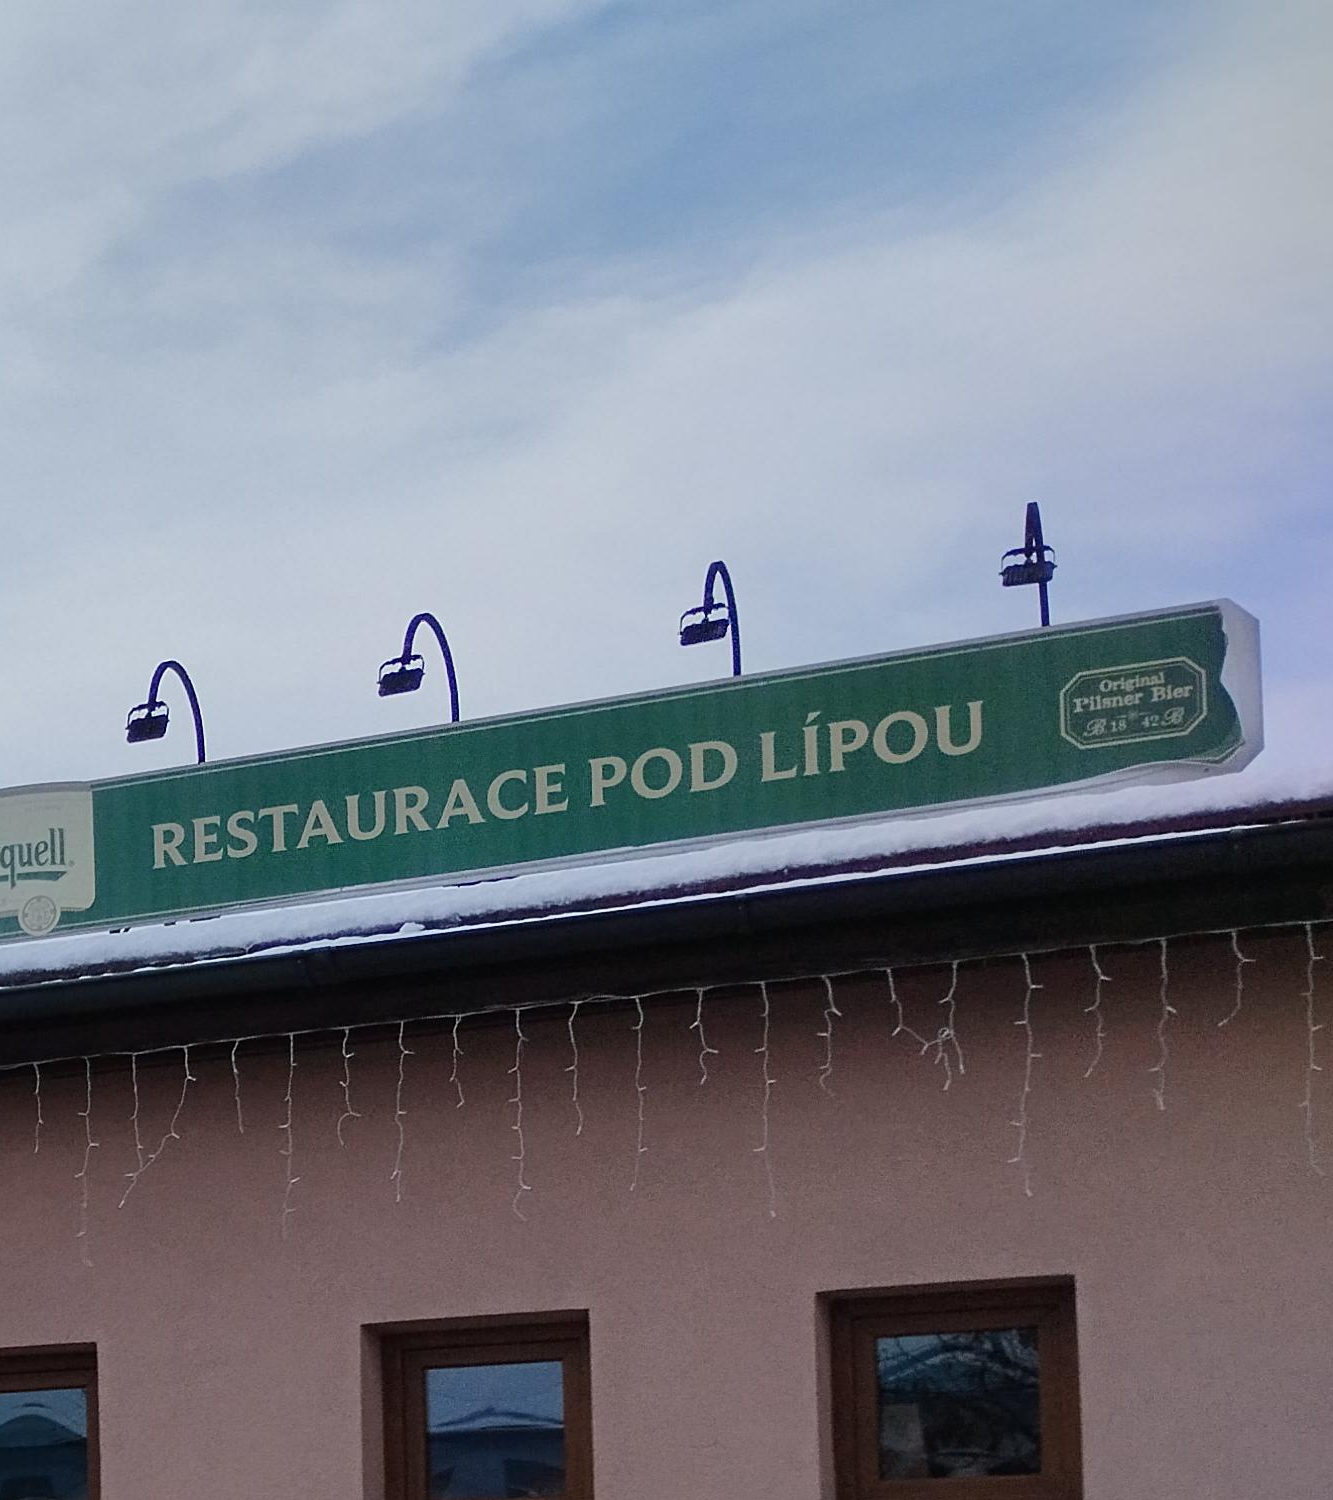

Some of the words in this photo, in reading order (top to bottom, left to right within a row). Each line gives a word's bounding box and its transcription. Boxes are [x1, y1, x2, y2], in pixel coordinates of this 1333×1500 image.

[1099, 671, 1165, 692] Original
[1073, 692, 1144, 713] Pilsner
[1151, 685, 1194, 702] Bier
[1110, 719, 1127, 732] 18
[1141, 715, 1159, 728] 42
[151, 763, 569, 870] RESTAURACE
[588, 740, 738, 808] POD
[759, 701, 983, 783] LÍPOU
